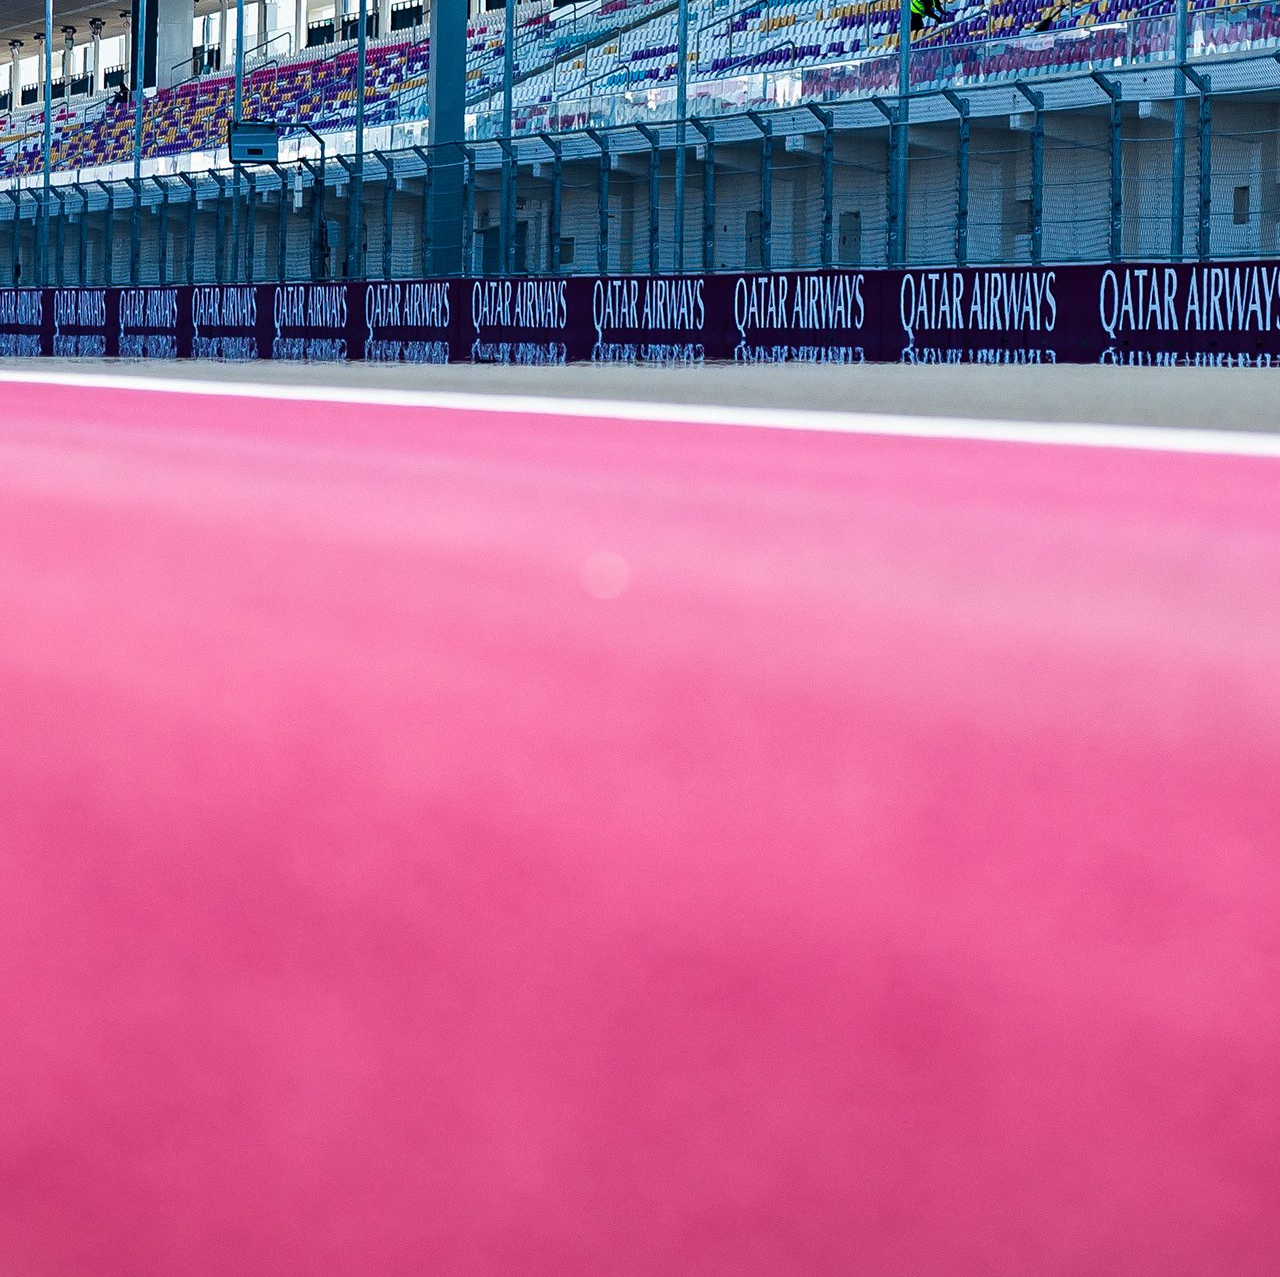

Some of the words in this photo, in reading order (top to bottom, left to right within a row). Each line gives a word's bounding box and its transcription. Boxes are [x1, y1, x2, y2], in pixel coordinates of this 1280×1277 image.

[192, 287, 220, 332] QATAR
[274, 286, 305, 333] QATAR
[307, 286, 347, 328] AIRWAYS
[366, 284, 401, 334] QATAR
[403, 282, 449, 327] AIRWAYS
[472, 281, 512, 333] QATAR
[513, 280, 567, 329] AIRWAYS
[593, 280, 638, 337] QATAR
[642, 279, 704, 330] AIRWAYS
[735, 276, 788, 337] QATAR
[791, 274, 864, 329] AIRWAYS
[900, 272, 964, 339] QATAR
[969, 272, 1056, 331] AIRWAYS
[1100, 268, 1178, 339] QATAR
